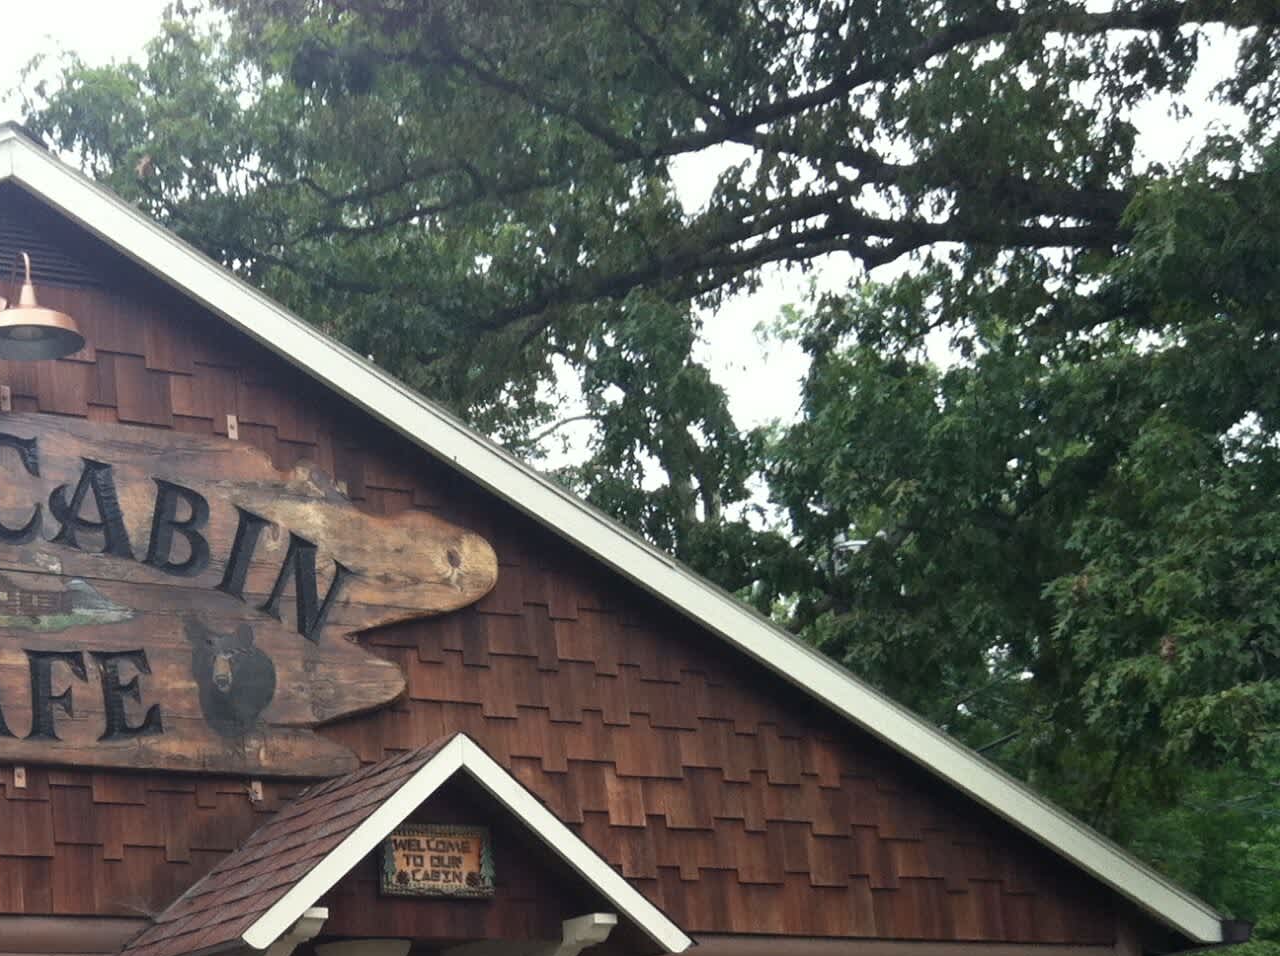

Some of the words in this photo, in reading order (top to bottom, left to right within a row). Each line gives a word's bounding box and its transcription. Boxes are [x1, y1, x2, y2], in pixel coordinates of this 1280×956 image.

[392, 838, 471, 854] WELCOME
[402, 853, 424, 867] TO
[411, 868, 464, 884] CABIN
